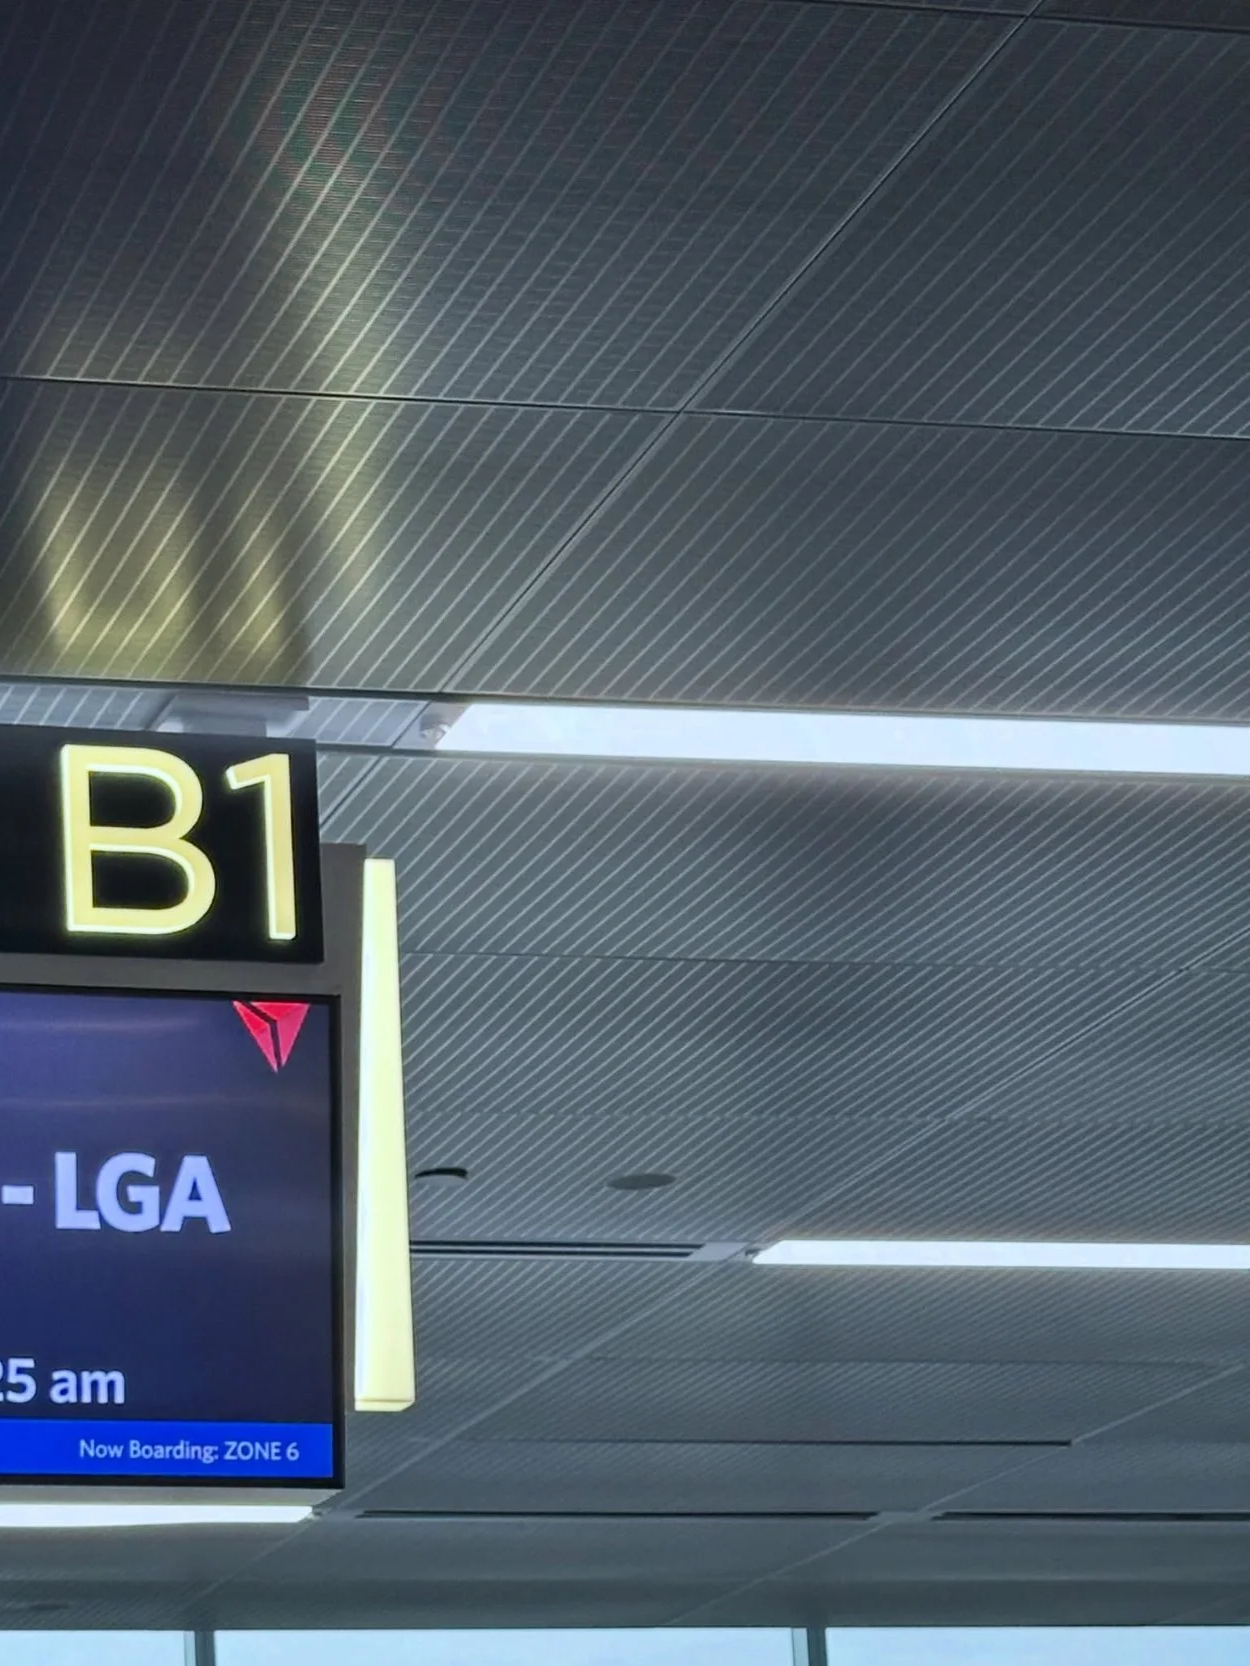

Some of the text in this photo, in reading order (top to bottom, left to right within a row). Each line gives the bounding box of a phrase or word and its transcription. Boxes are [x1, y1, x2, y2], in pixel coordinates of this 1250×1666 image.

[59, 743, 297, 941] B1
[0, 1183, 35, 1206] -
[54, 1151, 231, 1233] LGA
[49, 1369, 125, 1404] am
[79, 1439, 300, 1464] Now Boarding: ZONE 6
